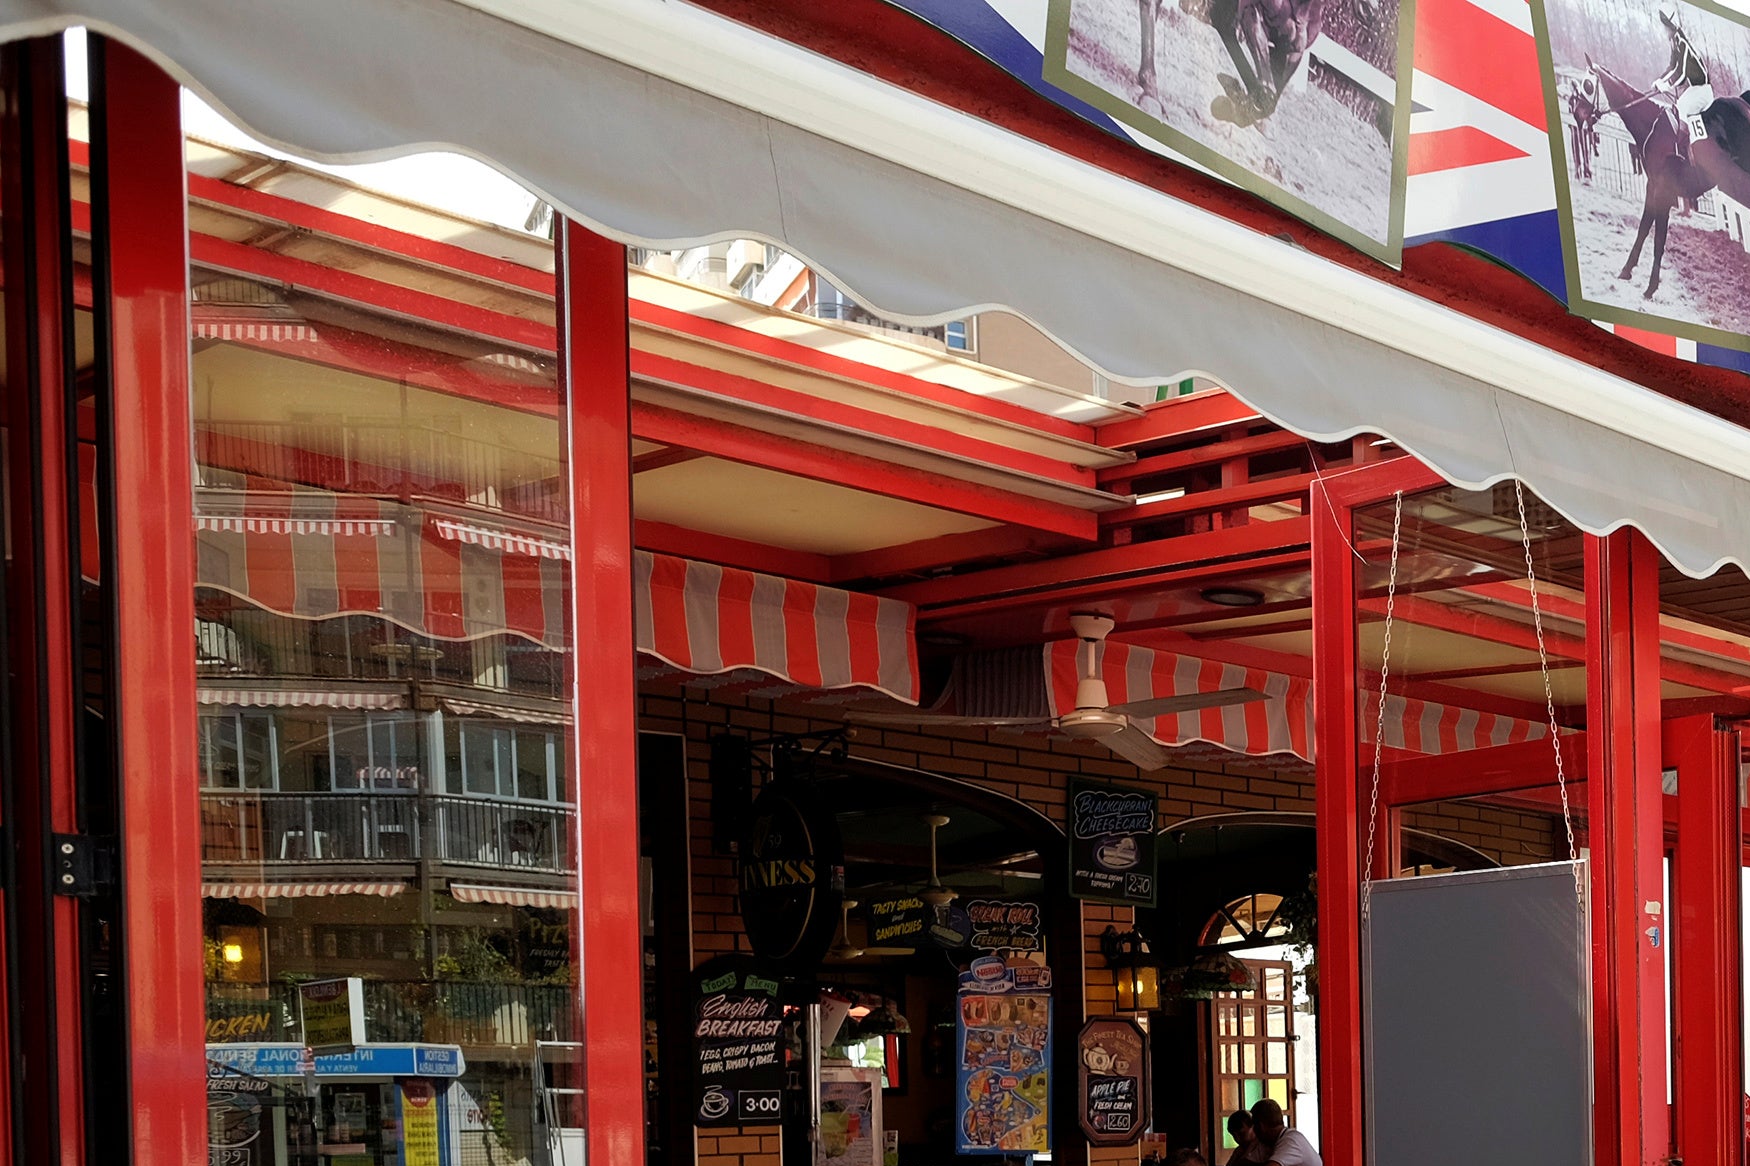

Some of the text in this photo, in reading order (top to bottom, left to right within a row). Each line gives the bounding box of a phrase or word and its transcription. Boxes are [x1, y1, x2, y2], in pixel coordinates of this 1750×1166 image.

[1691, 119, 1704, 137] 15
[1079, 794, 1153, 814] BLACKCURRANT
[1079, 816, 1149, 835] CHEESECAKE
[875, 918, 923, 941] SANDWICHES
[702, 993, 769, 1019] English
[206, 1011, 270, 1038] ICKEN
[696, 1019, 782, 1038] BREAKFAST
[238, 1080, 269, 1092] SALAD
